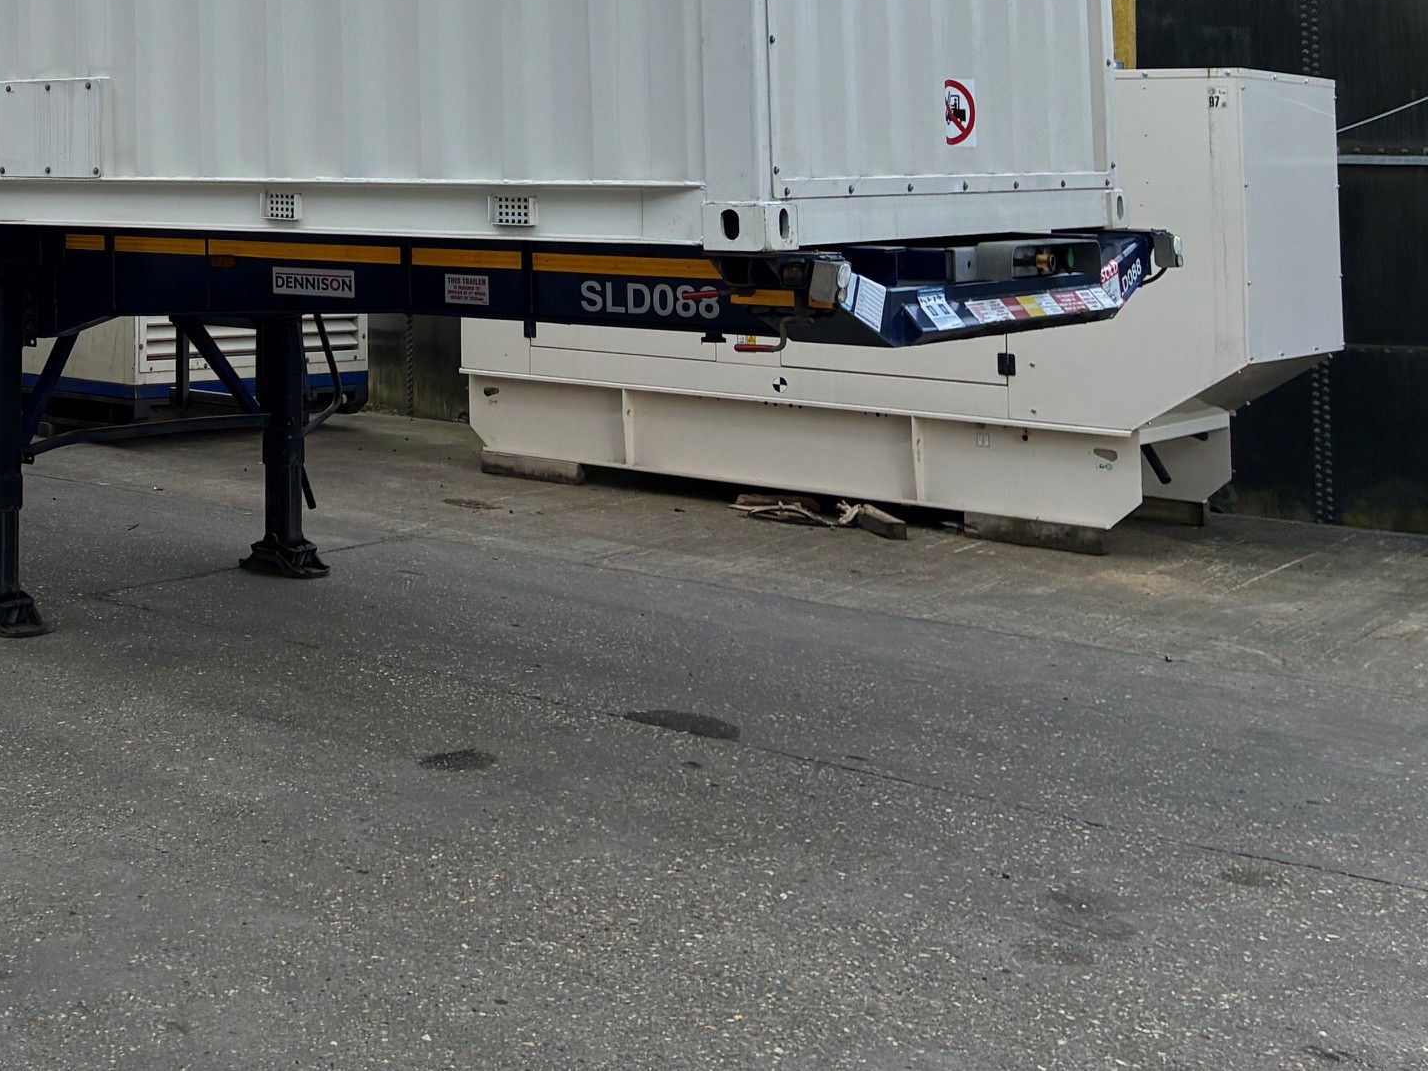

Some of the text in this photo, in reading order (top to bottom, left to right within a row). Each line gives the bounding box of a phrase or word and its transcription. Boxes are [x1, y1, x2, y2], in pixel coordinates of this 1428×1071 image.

[275, 274, 353, 293] DENNISON
[448, 277, 486, 286] THIS TRAILER
[580, 280, 720, 319] SLD088
